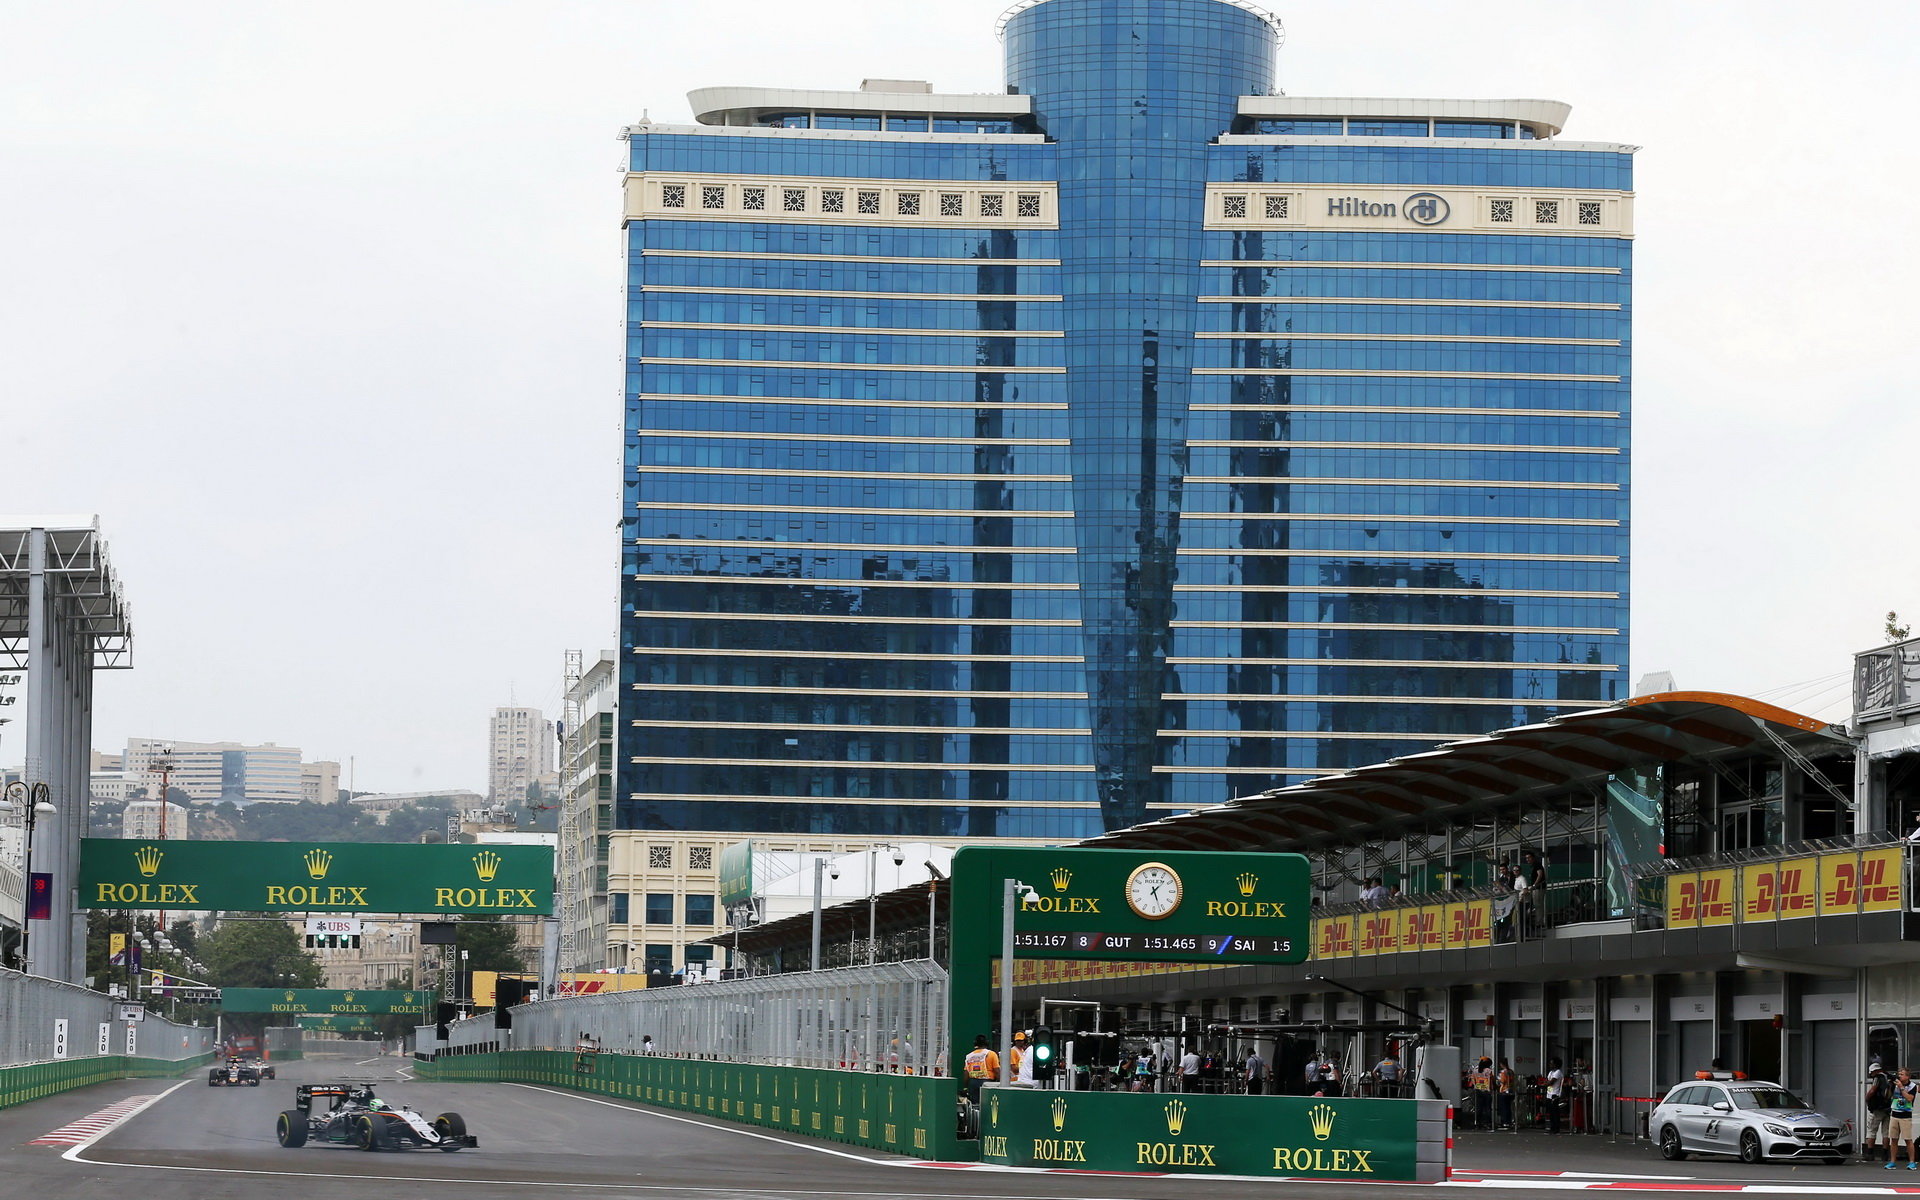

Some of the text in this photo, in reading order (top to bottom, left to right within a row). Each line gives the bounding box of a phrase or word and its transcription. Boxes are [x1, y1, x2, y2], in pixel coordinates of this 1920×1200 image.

[1327, 197, 1397, 217] Hilton
[1757, 869, 1805, 914] DHL
[1835, 859, 1889, 906] DHL
[97, 883, 537, 908] ROLEX ROLEX ROLEX
[1680, 878, 1723, 921] DHL
[1206, 901, 1286, 918] ROLEX
[328, 921, 351, 932] UBS
[1015, 934, 1291, 952] 1:51.167 8 GUT 1:51.465 9 SAI 1:5
[271, 1003, 308, 1012] ROLEX
[331, 1004, 368, 1013] ROLEX
[984, 1135, 1374, 1173] ROLEX ROLEX ROLEX ROLEX
